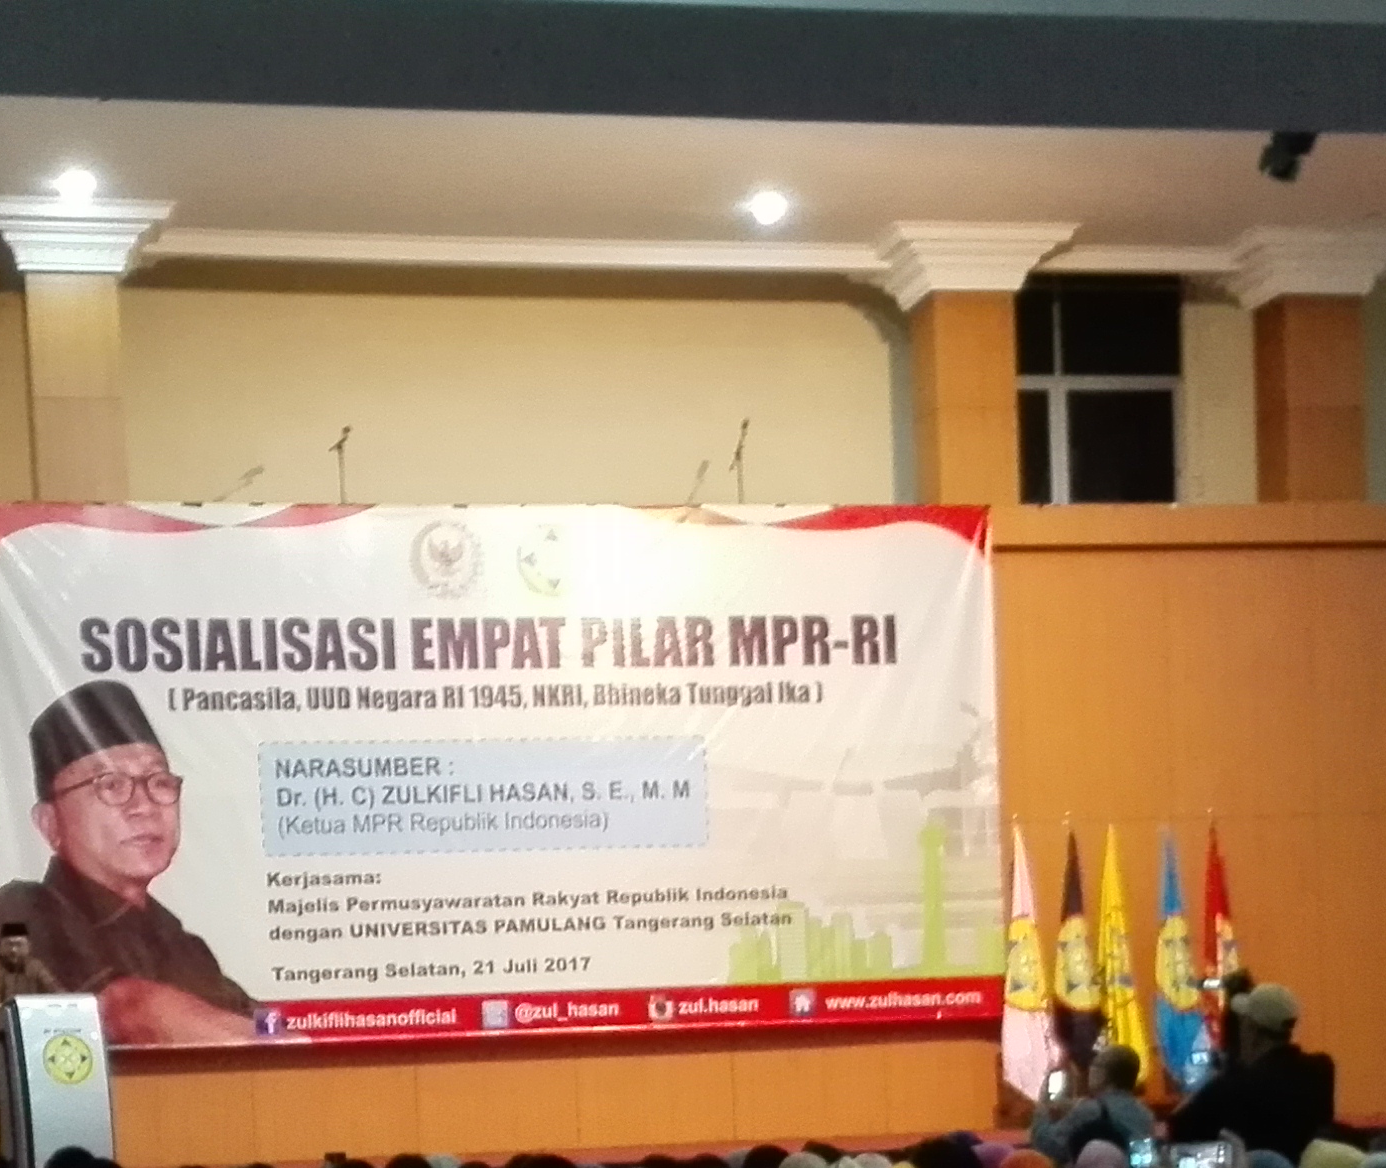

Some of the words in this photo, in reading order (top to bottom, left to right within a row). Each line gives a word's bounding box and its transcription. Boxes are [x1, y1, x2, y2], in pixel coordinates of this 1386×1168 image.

[79, 617, 396, 673] SOSIALISASI
[410, 616, 566, 670] EMPAT
[580, 615, 714, 669] PILAR
[728, 614, 898, 668] MPR-RI
[182, 686, 301, 713] Pancasila,
[306, 685, 350, 711] UUD
[357, 685, 437, 713] Negara
[442, 685, 465, 710] RI
[469, 684, 527, 712] 1945,
[532, 683, 589, 710] NKRI,
[593, 682, 681, 708] Bhineka
[686, 681, 773, 708] Tunggal
[778, 680, 811, 705] Ika
[275, 756, 442, 778] NARASUMBER
[276, 787, 307, 808] Dr.
[314, 786, 344, 811] (H.
[351, 785, 375, 810] C)
[382, 784, 482, 805] ZULKIFLI
[489, 781, 575, 804] HASAN,
[581, 781, 602, 801] S.
[642, 780, 665, 800] M.
[672, 779, 690, 799] M
[278, 815, 345, 839] (Ketua
[353, 813, 403, 834] MPR
[410, 812, 498, 836] Republik
[505, 809, 610, 832] Indonesia)
[266, 871, 382, 889] Kerjasama:
[268, 897, 339, 917] Majelis
[346, 894, 525, 913] Permusyawaratan
[532, 890, 600, 909] Rakyat
[606, 887, 689, 907] Republik
[696, 885, 788, 903] Indonesia
[269, 925, 343, 943] dengan
[350, 919, 488, 938] UNIVERSITAS
[494, 915, 606, 934] PAMULANG
[612, 913, 715, 932] Tangerang
[720, 911, 792, 928] Selatan
[271, 965, 379, 984] Tangerang
[385, 961, 466, 979] Selatan,
[472, 959, 495, 975] 21
[502, 957, 538, 974] Juli
[544, 956, 591, 972] 2017
[515, 1001, 619, 1024] @zul_hasan
[678, 996, 759, 1015] zul.hasan
[824, 990, 982, 1011] www.zulhasan.com
[286, 1008, 456, 1031] zulkiflihasanofficial
